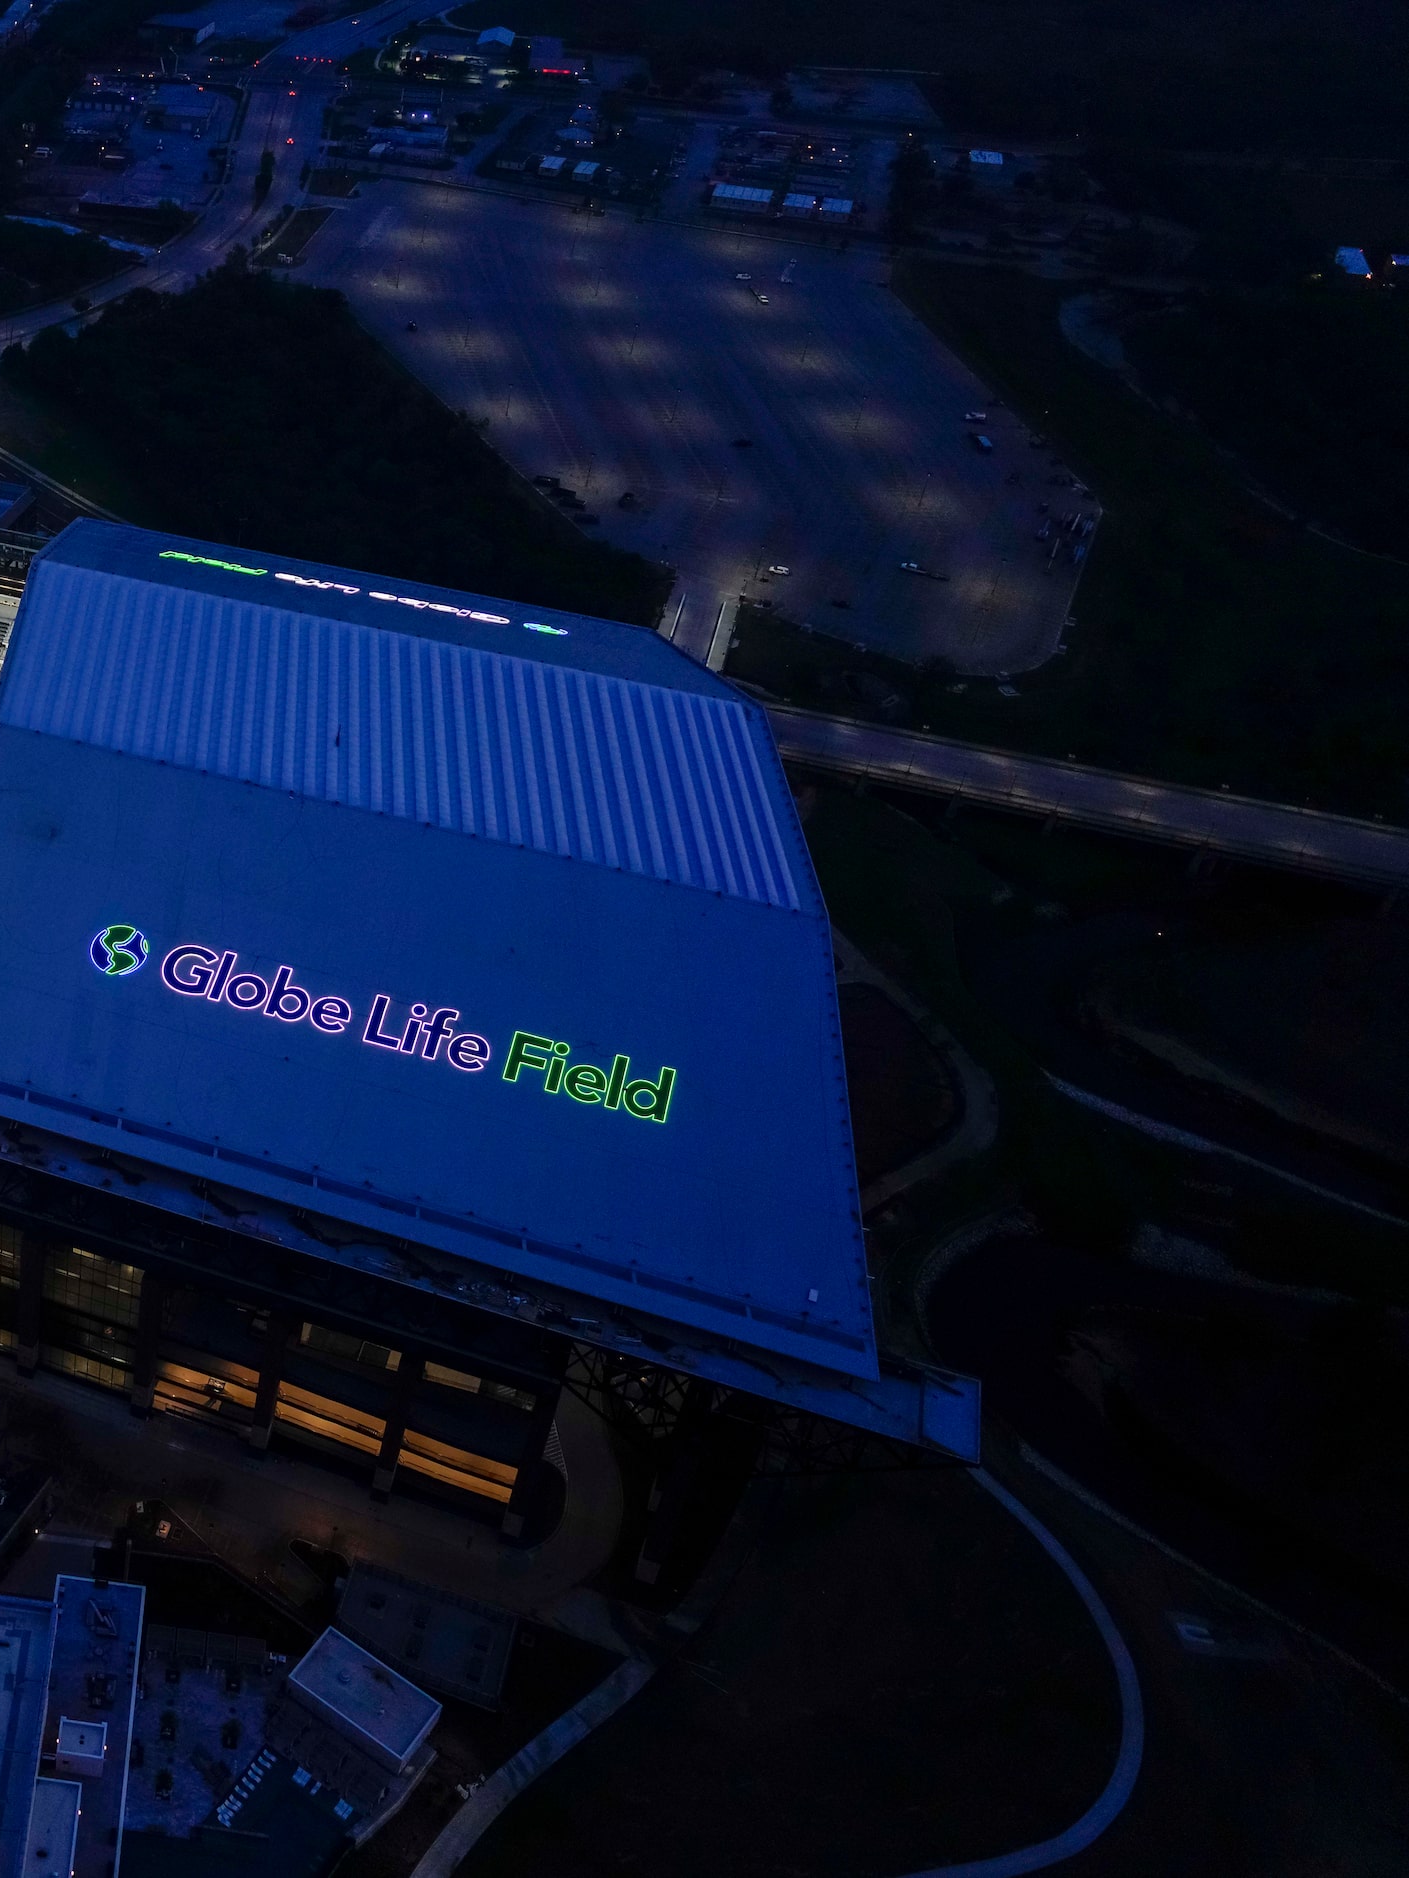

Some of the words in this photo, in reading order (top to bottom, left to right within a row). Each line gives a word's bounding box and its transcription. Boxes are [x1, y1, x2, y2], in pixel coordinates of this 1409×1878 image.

[160, 944, 352, 1034] Globe
[362, 993, 491, 1072] Life
[502, 1030, 677, 1124] Field
